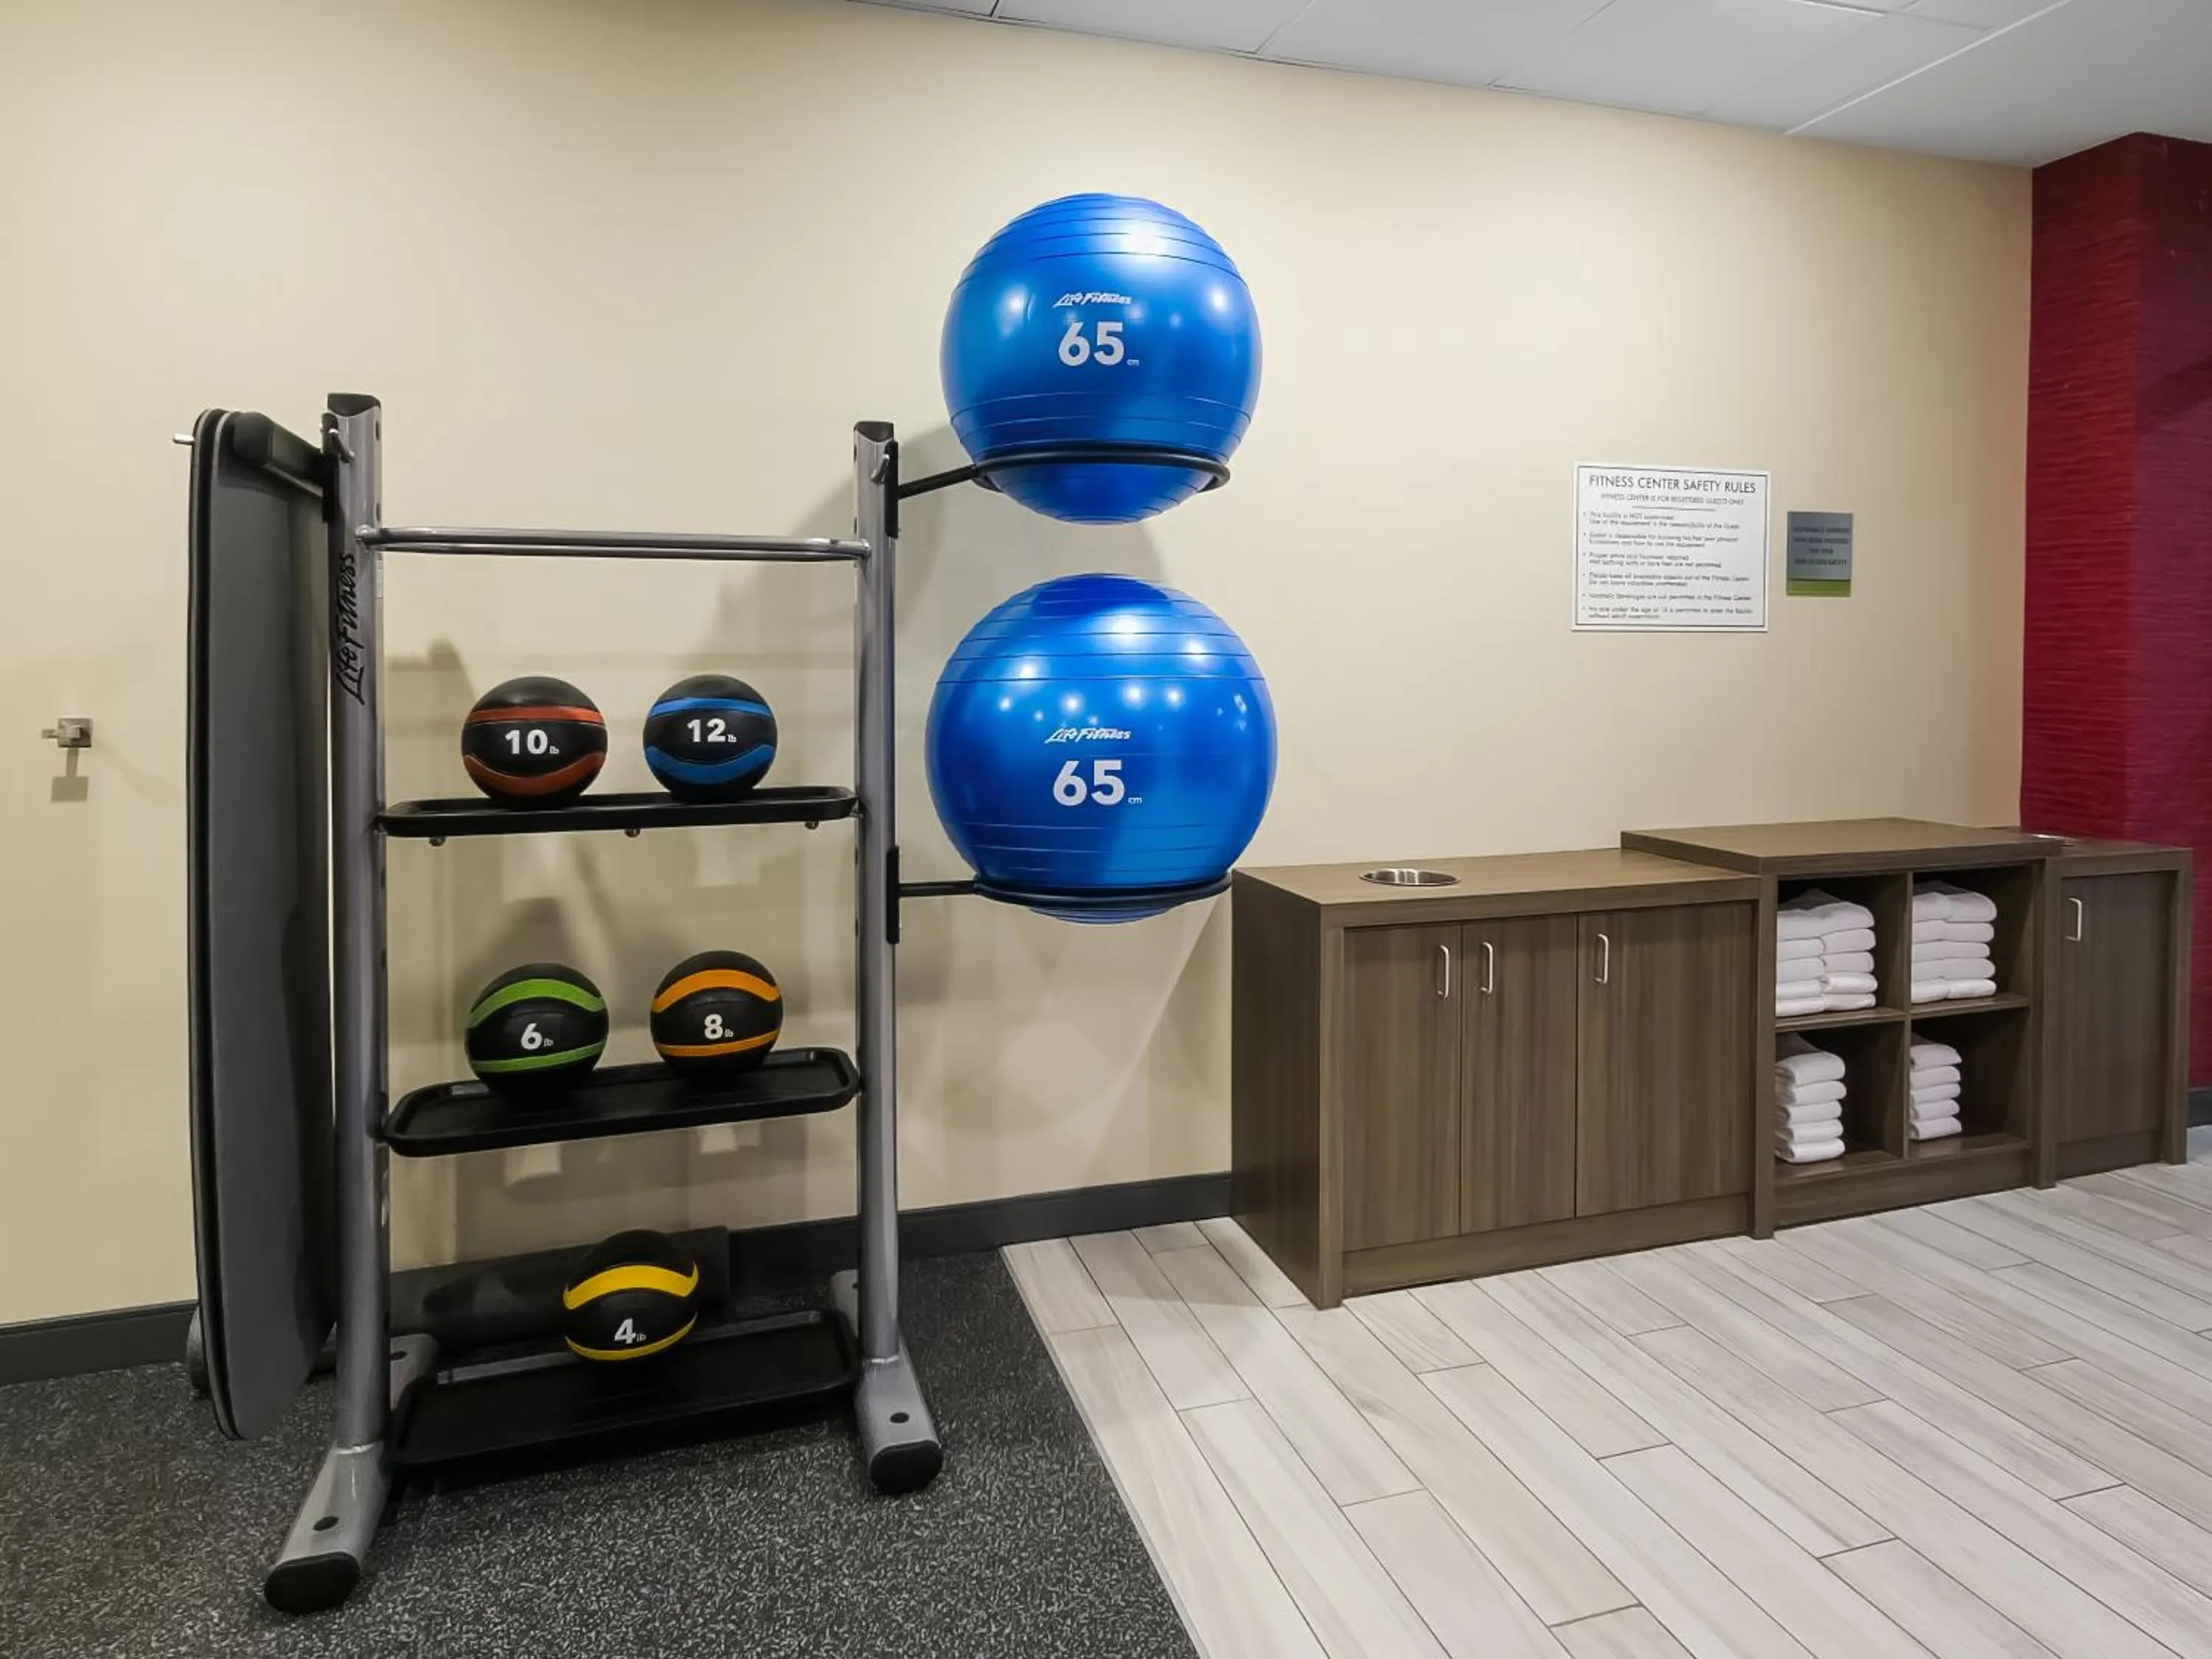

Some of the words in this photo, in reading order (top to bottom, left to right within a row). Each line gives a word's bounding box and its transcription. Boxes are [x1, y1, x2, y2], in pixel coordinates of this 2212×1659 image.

[1058, 321, 1125, 366] 65
[1590, 475, 1634, 487] FITNESS
[1638, 477, 1679, 490] CENTER
[1683, 479, 1720, 493] SAFETY
[1725, 481, 1756, 493] RULES
[1627, 493, 1649, 501] CENTER
[504, 728, 549, 755] 10
[549, 745, 560, 755] lb
[686, 717, 727, 743] 12
[727, 733, 738, 743] lb
[1052, 759, 1125, 807] 65
[1127, 796, 1143, 805] cm
[520, 1022, 543, 1051] 6
[543, 1037, 554, 1048] lb
[703, 1013, 724, 1040] 8
[723, 1029, 734, 1038] lb
[613, 1317, 637, 1345] 4
[636, 1332, 647, 1343] lb
